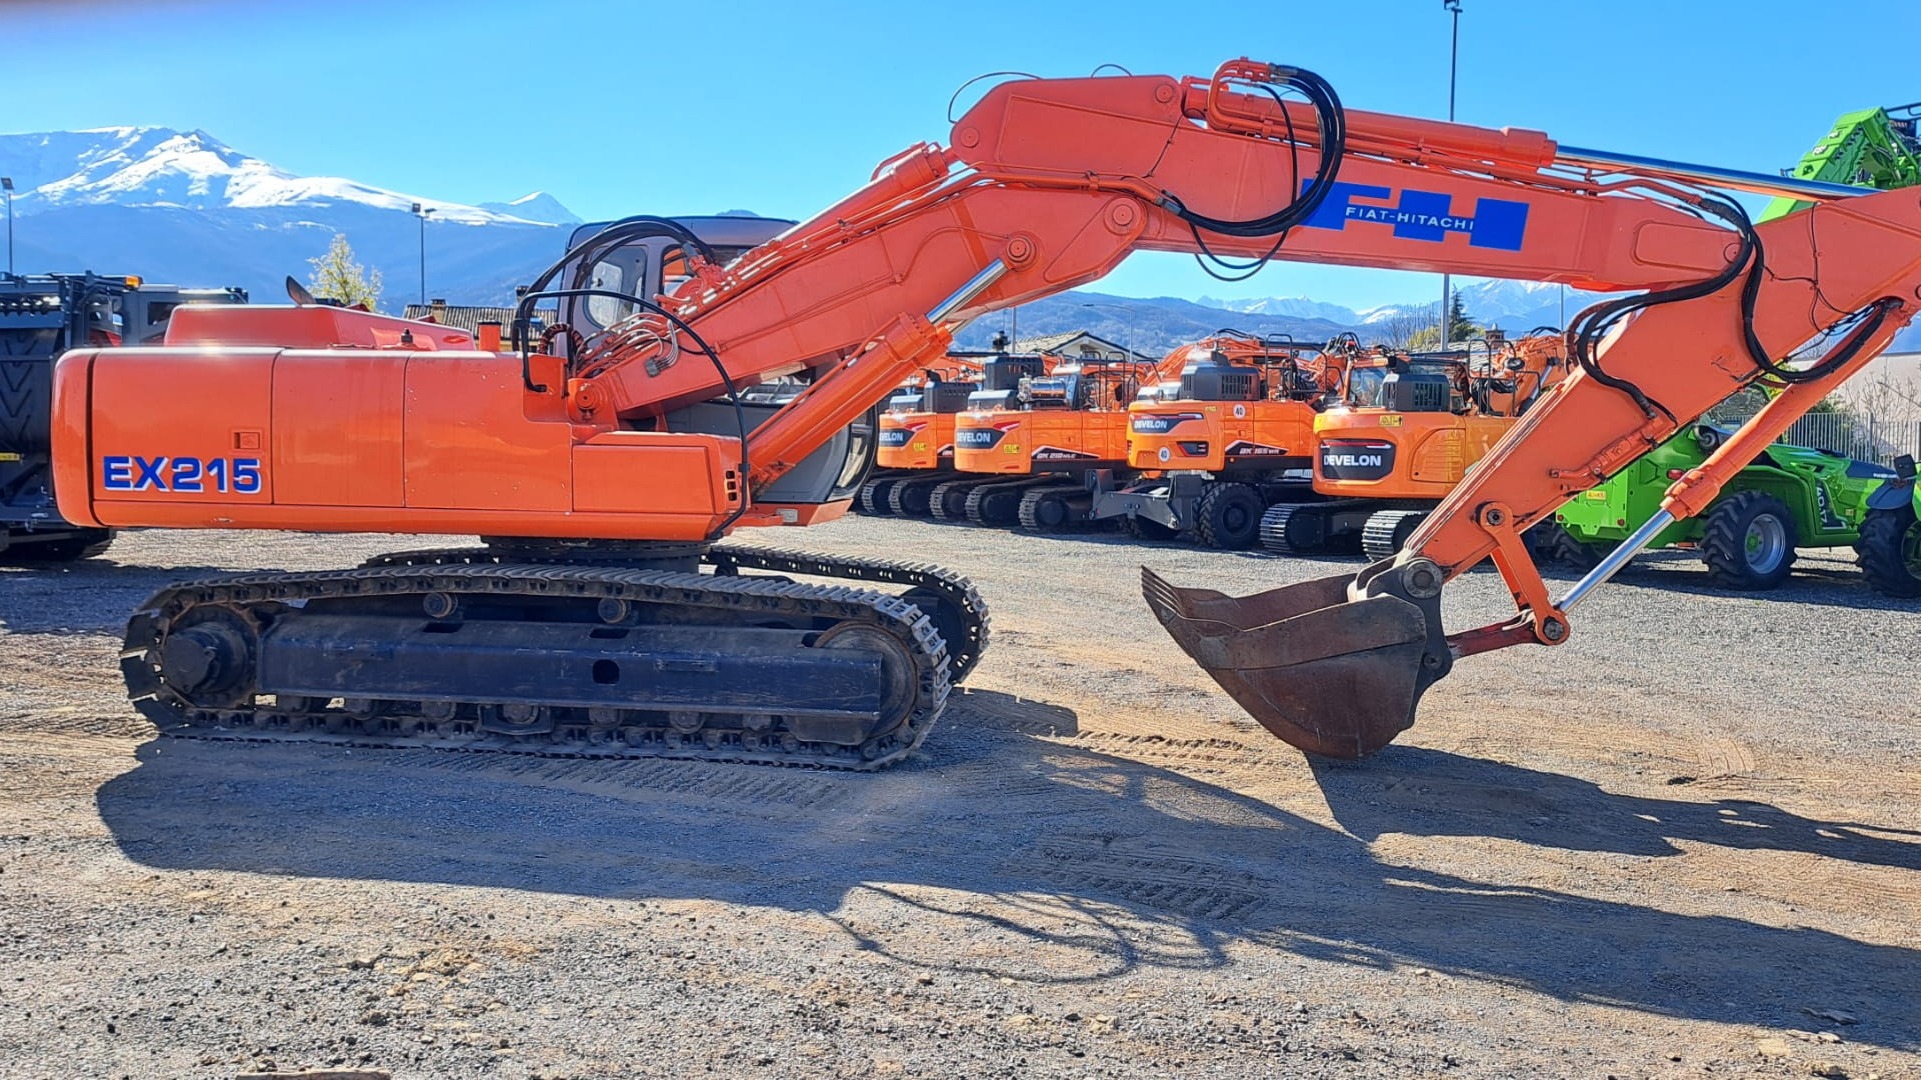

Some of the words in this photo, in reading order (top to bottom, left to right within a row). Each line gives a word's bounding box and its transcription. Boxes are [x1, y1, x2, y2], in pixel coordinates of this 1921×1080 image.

[1345, 206, 1475, 231] FIAT-HITACHI
[1235, 407, 1244, 416] 40
[1134, 420, 1168, 429] DEVELON
[1323, 454, 1382, 466] DEVELON
[103, 456, 263, 494] EX215
